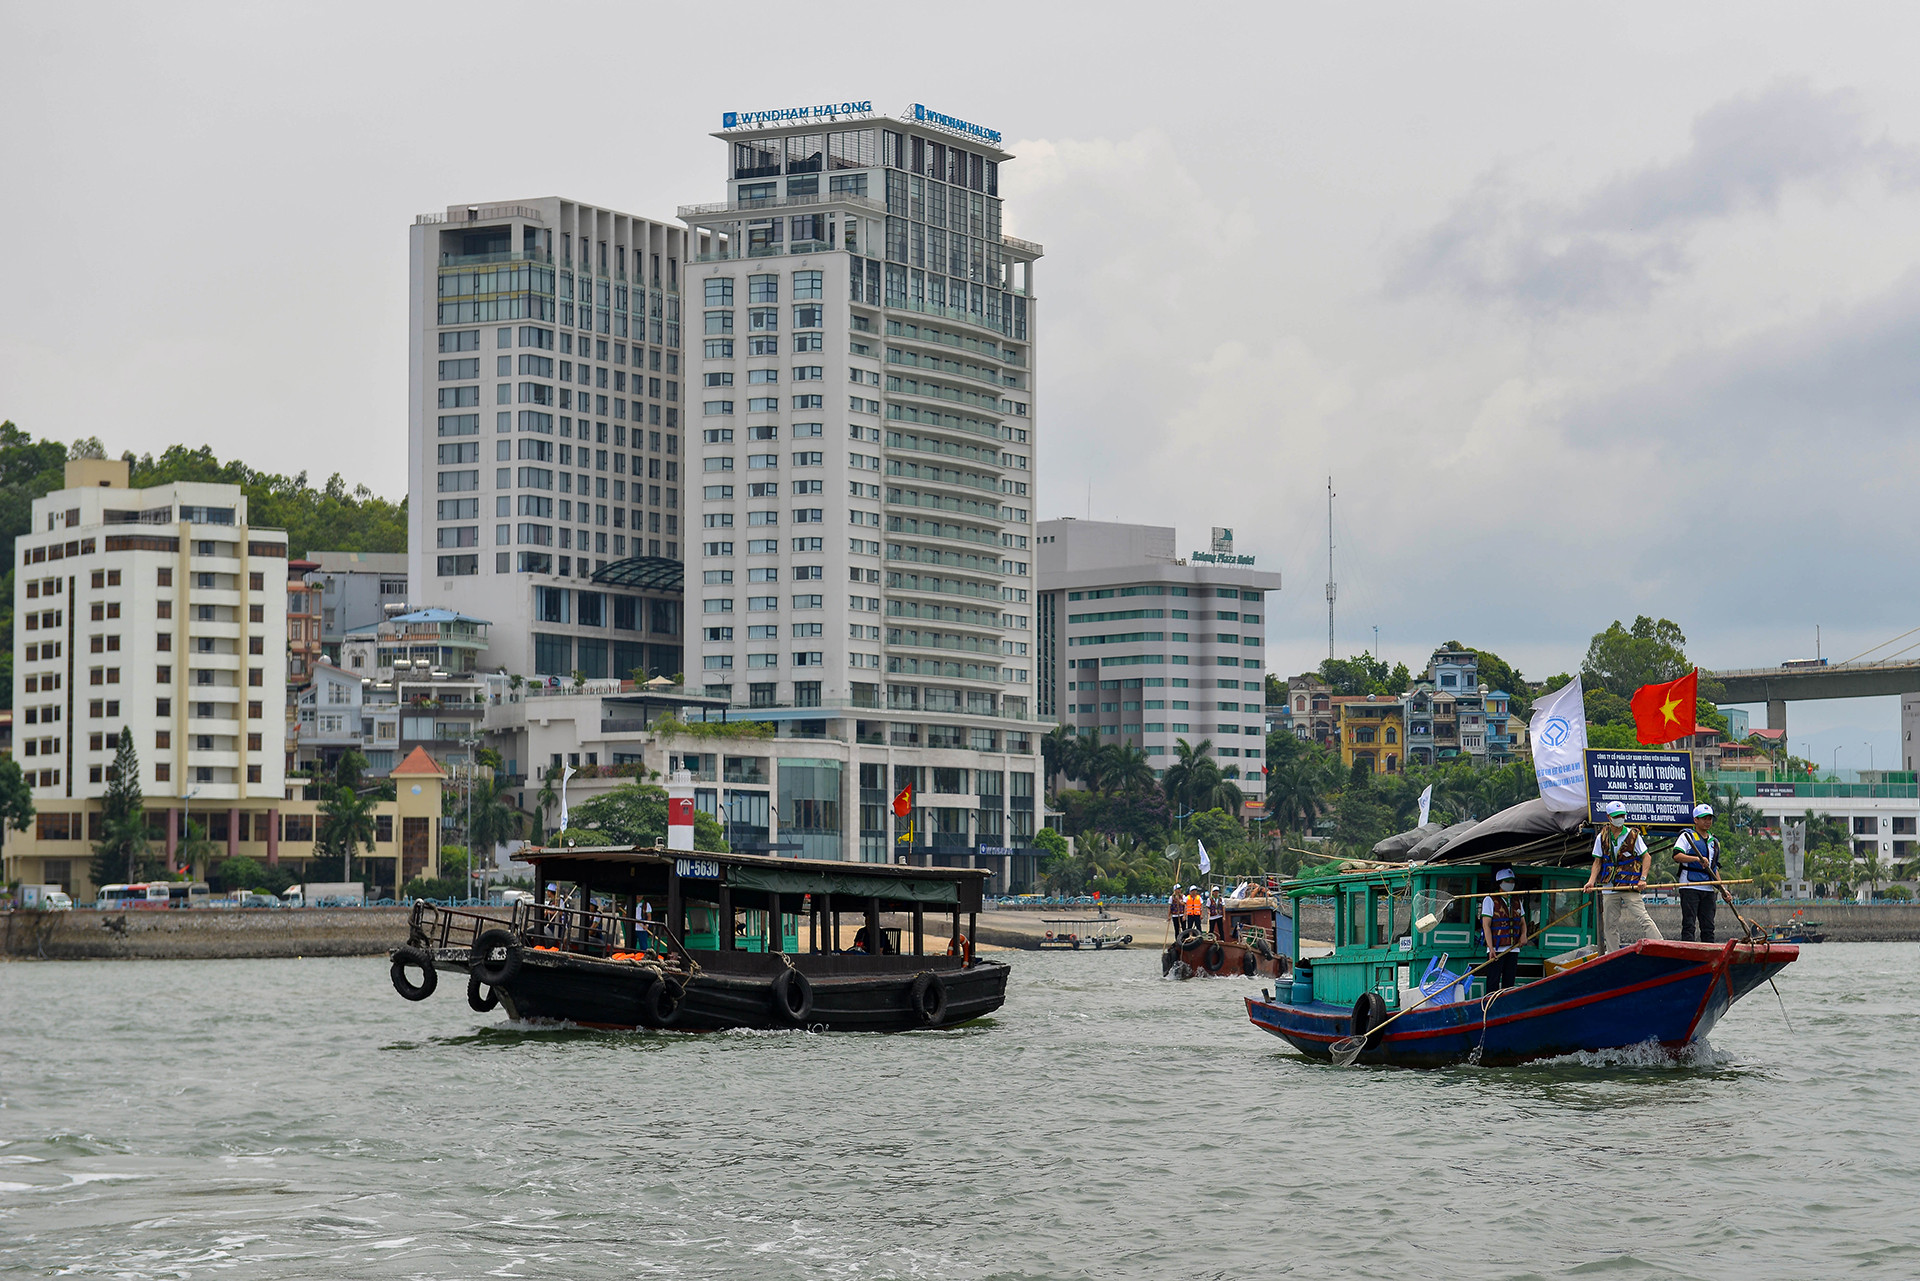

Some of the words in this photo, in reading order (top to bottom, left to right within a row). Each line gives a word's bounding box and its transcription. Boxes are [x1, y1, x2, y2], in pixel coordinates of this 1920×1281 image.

[741, 107, 808, 123] WYNDHAM
[813, 101, 872, 116] HALONG
[926, 110, 967, 131] WYNDHAM
[968, 123, 1002, 142] HALONG
[1593, 762, 1608, 778] TÀU
[1610, 761, 1626, 778] BẢO
[1627, 763, 1637, 781] VỆ
[1638, 763, 1654, 779] MÔI
[1655, 764, 1686, 780] TRƯỜNG
[1607, 781, 1628, 789] XANH
[1634, 782, 1653, 791] SẠCH
[1660, 783, 1674, 792] ĐẸP
[1656, 804, 1689, 814] PROTECTION
[676, 859, 719, 876] QN-5630
